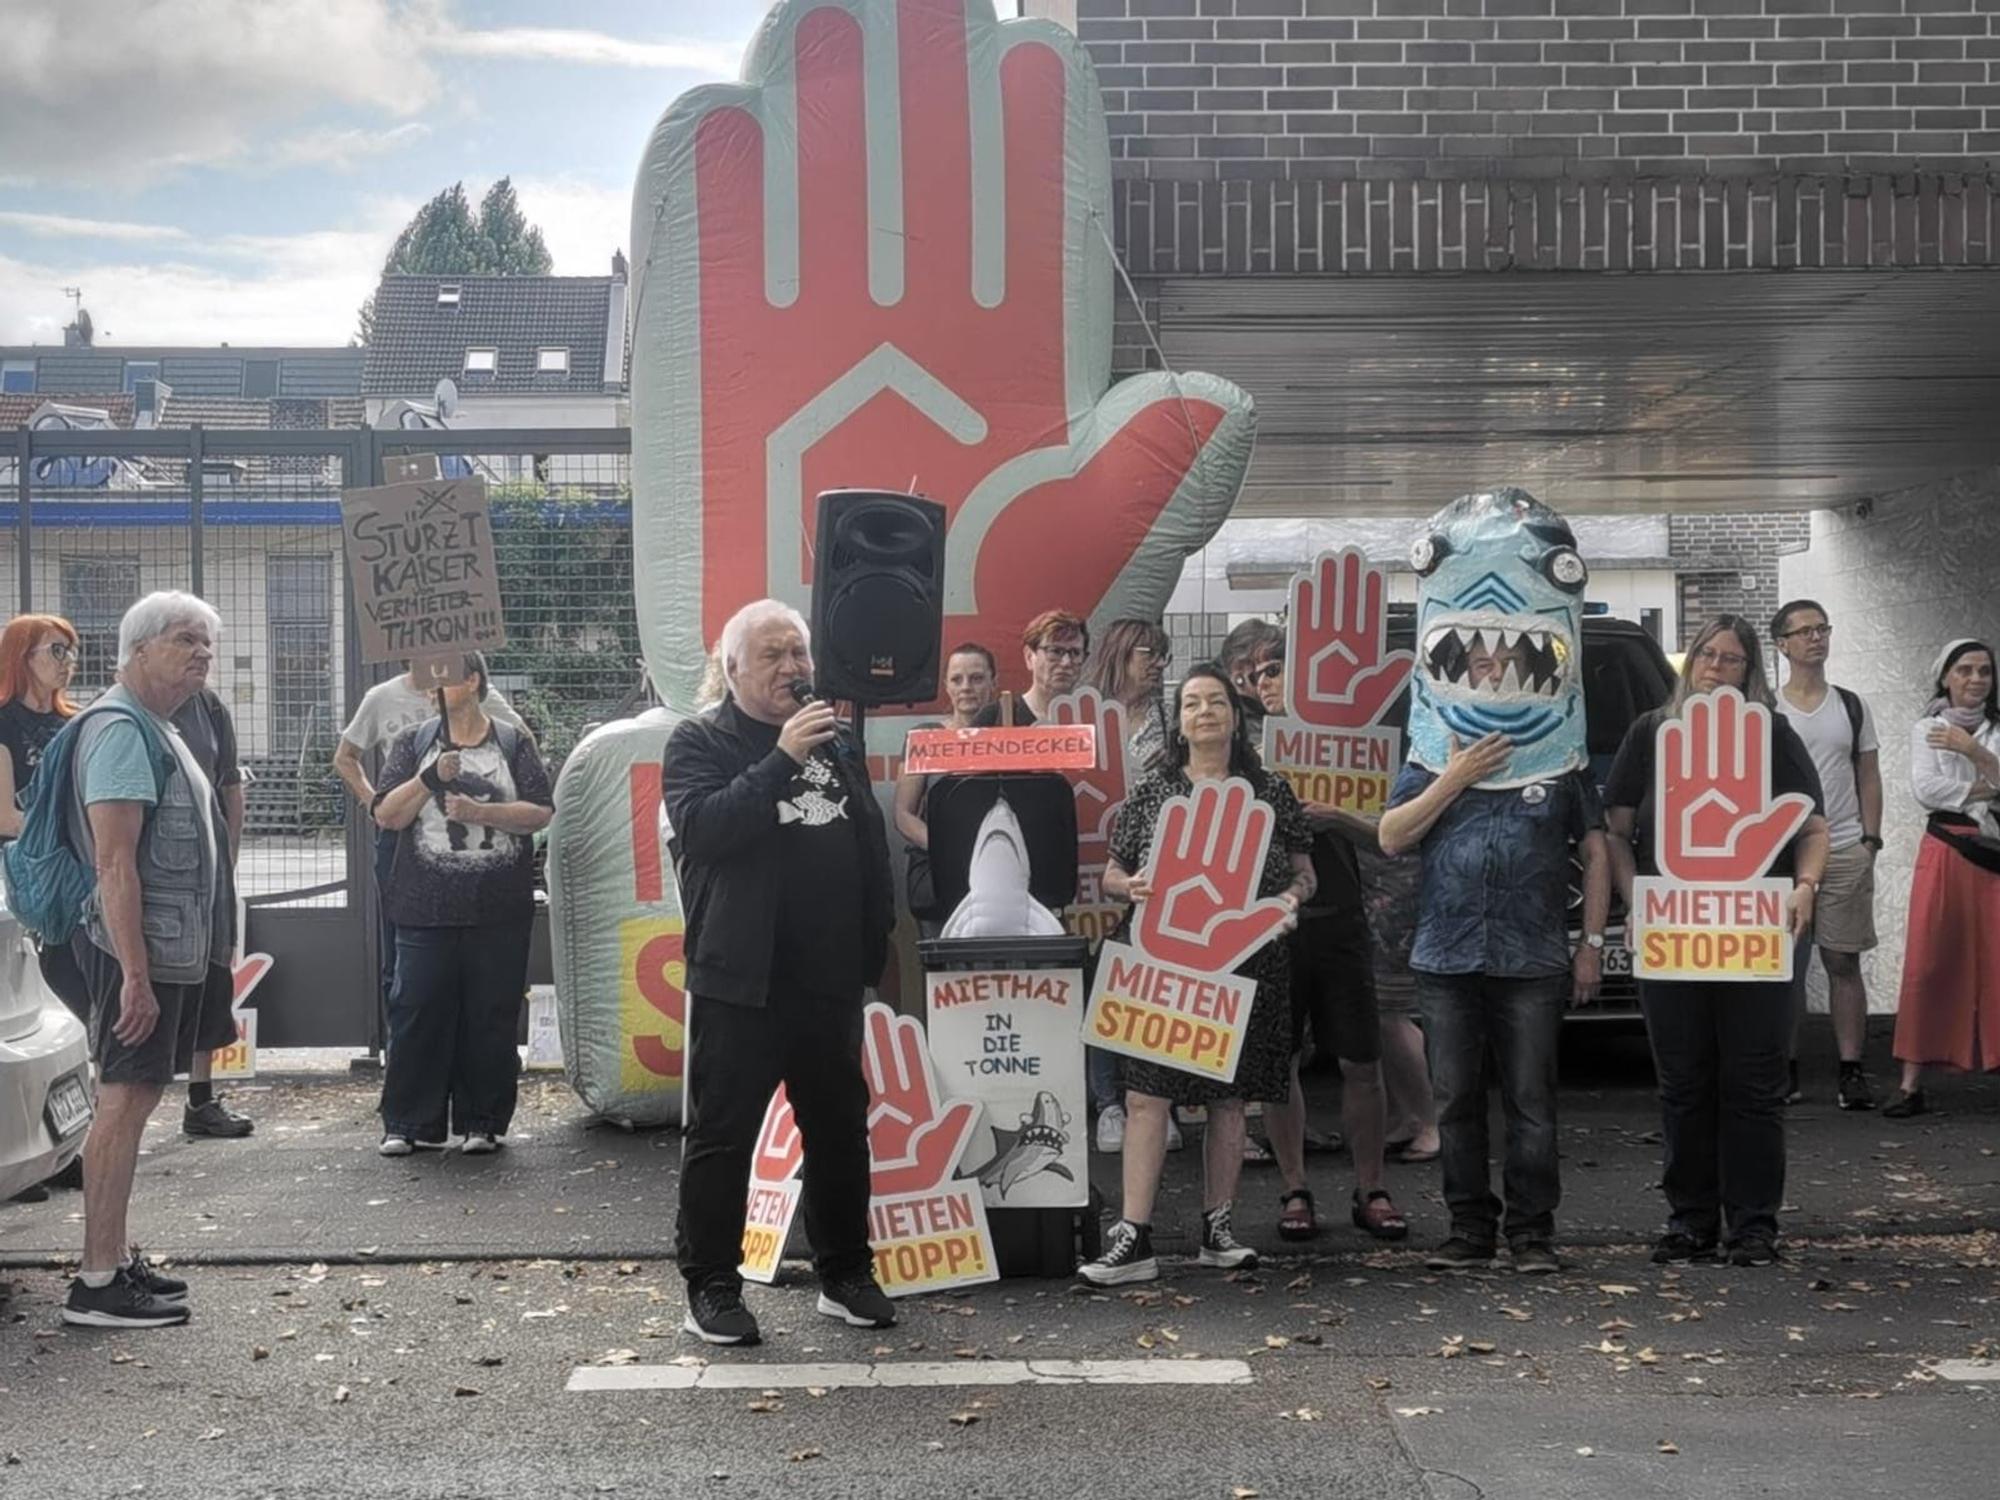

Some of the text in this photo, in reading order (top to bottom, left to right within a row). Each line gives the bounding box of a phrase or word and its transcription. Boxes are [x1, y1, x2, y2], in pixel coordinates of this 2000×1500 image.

[353, 511, 482, 562] STÜRZT
[909, 736, 1092, 759] MIETENDECKEL
[1275, 728, 1390, 772] MIETEN
[1279, 770, 1388, 811] TOPP!
[1645, 888, 1780, 927] MIETEN
[1644, 931, 1780, 970] STOPP!
[934, 973, 1070, 1010] MIETHAI
[1106, 956, 1241, 1025] MIETEN
[985, 1013, 1012, 1032] IN
[1096, 1000, 1231, 1068] STOPP!
[983, 1034, 1021, 1053] DIE
[964, 1057, 1040, 1077] TONNE
[874, 1235, 984, 1285] TOPP!
